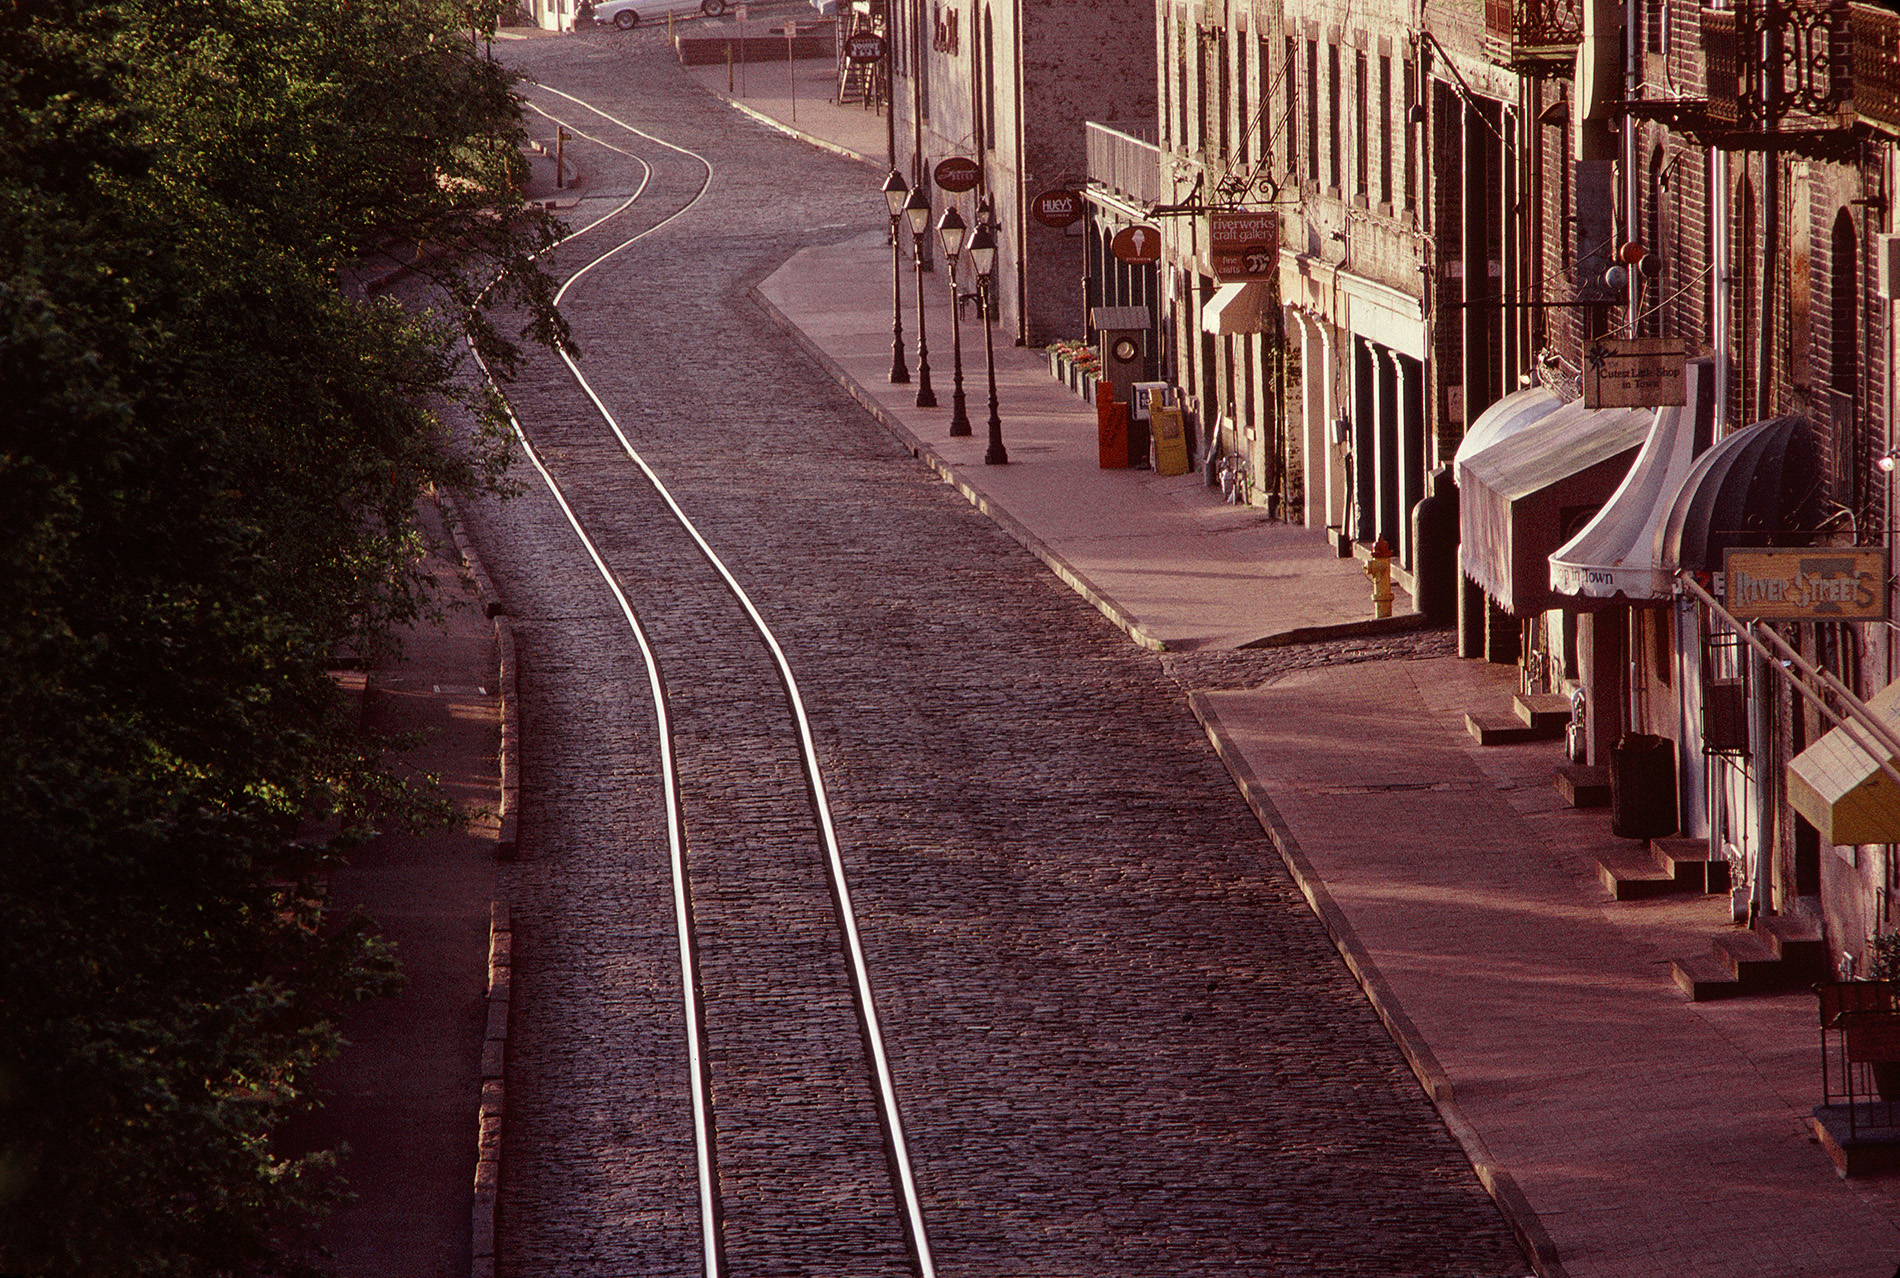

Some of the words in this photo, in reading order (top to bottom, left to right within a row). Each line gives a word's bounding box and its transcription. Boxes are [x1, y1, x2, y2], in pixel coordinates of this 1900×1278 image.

[1042, 197, 1072, 211] HUEY'S
[1213, 218, 1275, 229] riverworks
[1213, 229, 1237, 241] craft
[1239, 228, 1274, 243] gallery
[1222, 256, 1238, 265] fine
[1218, 266, 1241, 274] crafts
[1600, 368, 1631, 379] Cutest
[1632, 367, 1653, 378] Little
[1656, 366, 1680, 379] Shop
[1622, 380, 1631, 389] in
[1634, 379, 1660, 388] Town
[1571, 567, 1580, 581] in
[1582, 568, 1613, 585] Town
[1736, 572, 1790, 607] RIVER
[1793, 572, 1861, 607] STREET
